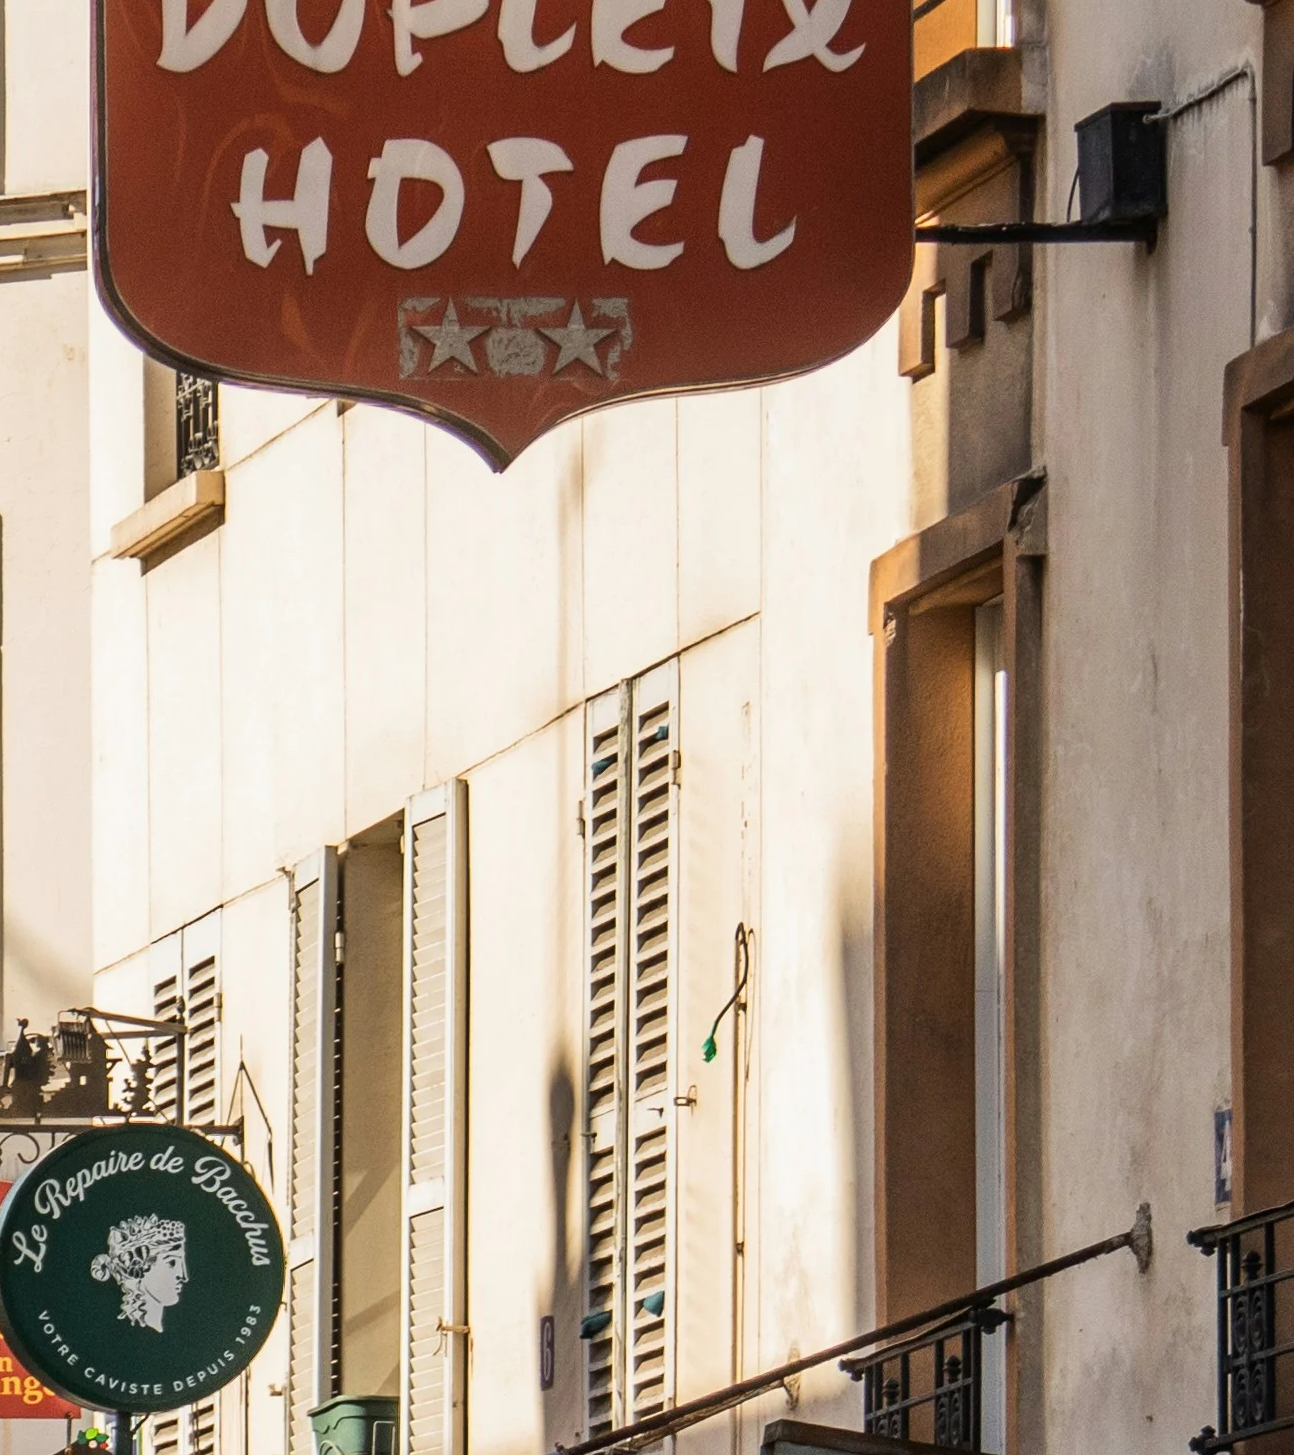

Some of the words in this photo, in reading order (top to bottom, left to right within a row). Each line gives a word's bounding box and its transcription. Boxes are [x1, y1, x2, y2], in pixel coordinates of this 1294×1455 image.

[229, 133, 797, 276] HOTEL
[12, 1218, 48, 1274] Le
[34, 1149, 146, 1221] Repaire
[150, 1144, 185, 1175] de
[192, 1154, 271, 1268] Bacchus
[38, 1309, 79, 1367] VOTRE
[84, 1365, 164, 1397] CAVISTE
[173, 1348, 237, 1394] DEPUIS
[235, 1303, 263, 1347] 1983
